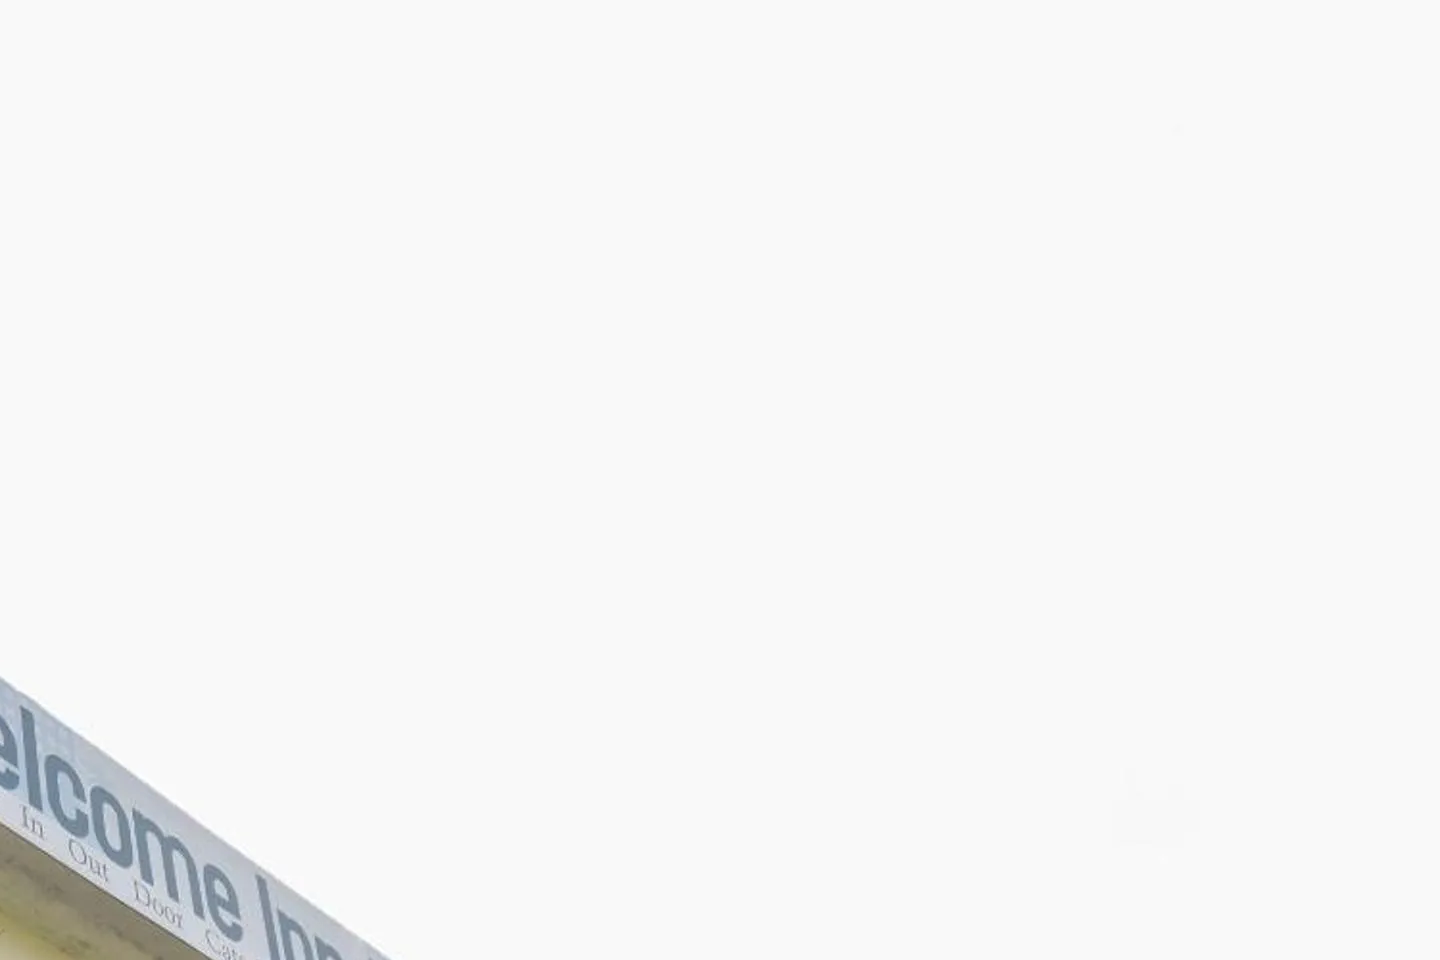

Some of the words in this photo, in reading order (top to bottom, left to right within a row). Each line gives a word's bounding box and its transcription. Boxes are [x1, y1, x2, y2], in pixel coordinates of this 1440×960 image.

[20, 804, 46, 841] In
[68, 838, 109, 883] Out
[134, 880, 184, 930] Door
